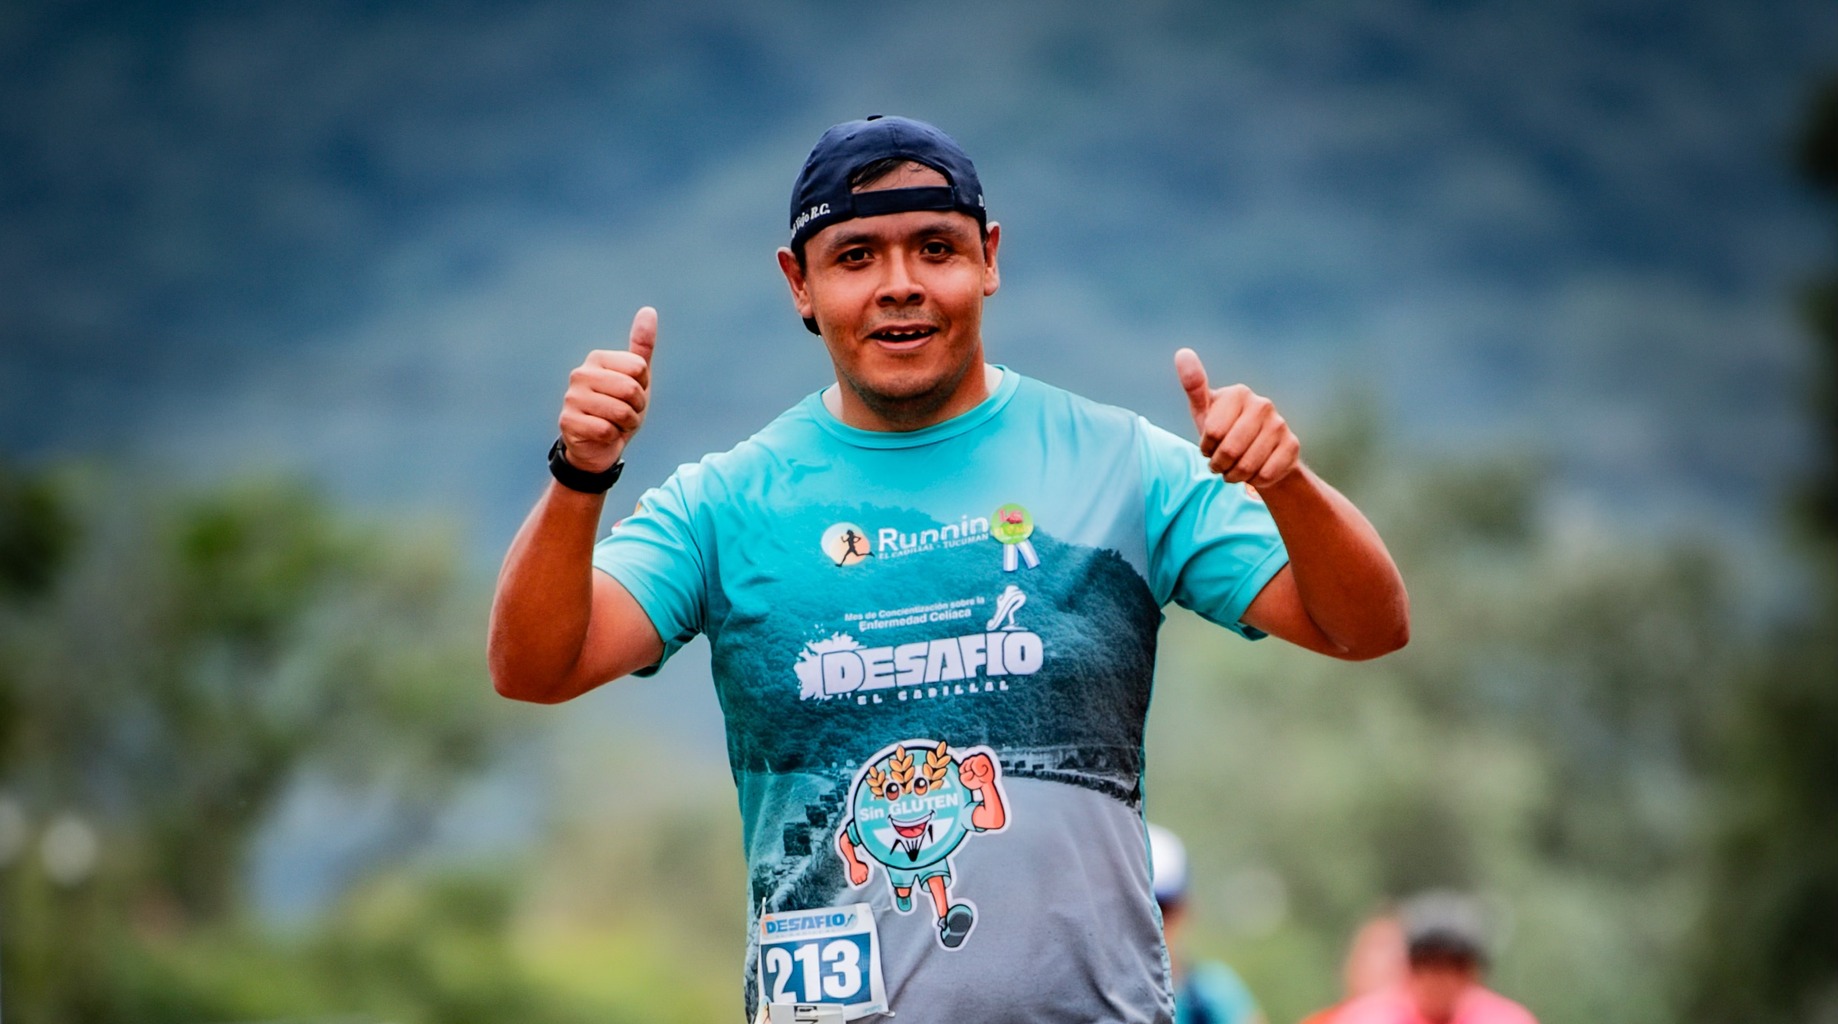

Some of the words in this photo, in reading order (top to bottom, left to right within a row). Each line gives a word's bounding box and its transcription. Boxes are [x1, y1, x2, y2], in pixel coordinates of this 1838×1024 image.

[810, 203, 831, 220] R.C.
[878, 514, 990, 552] Runnin
[844, 612, 864, 622] Mes
[865, 611, 878, 621] de
[949, 598, 975, 610] sobre
[975, 595, 986, 605] la
[858, 613, 928, 632] Enfermedad
[857, 693, 883, 705] EL
[898, 680, 1009, 701] CADILLAL
[860, 806, 885, 821] Sin
[888, 792, 959, 817] GLUTEN
[765, 938, 862, 1003] 213
